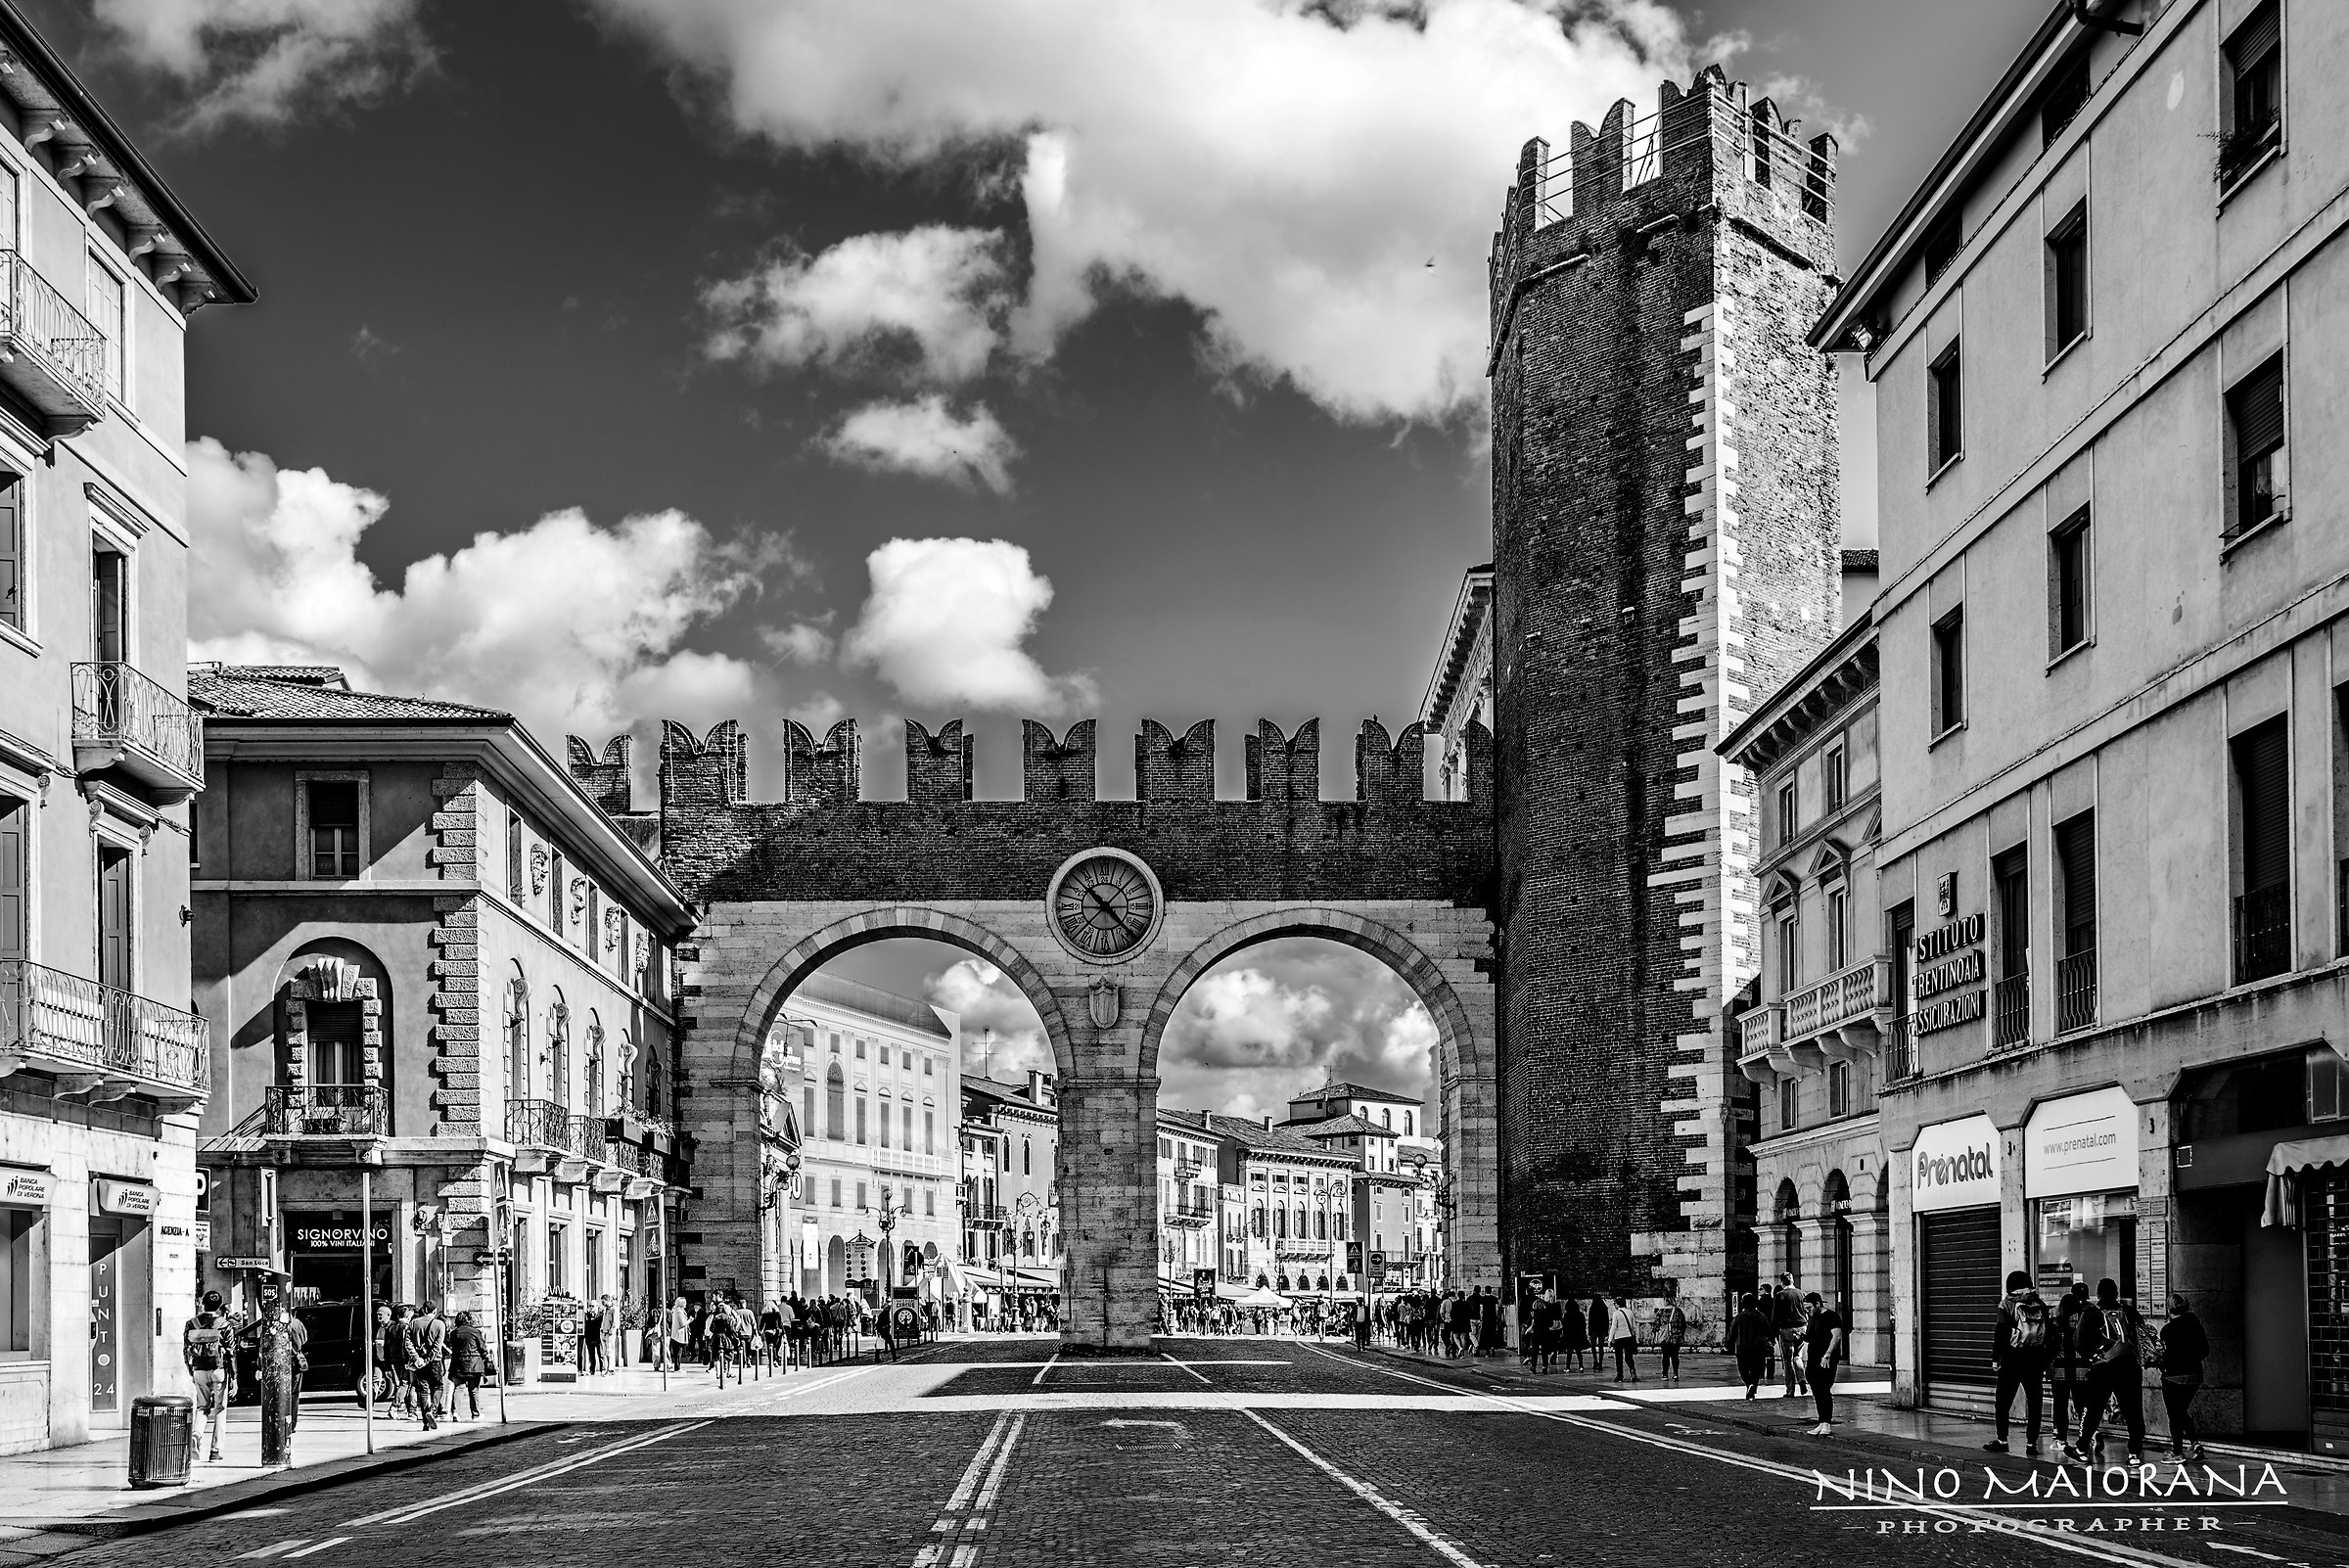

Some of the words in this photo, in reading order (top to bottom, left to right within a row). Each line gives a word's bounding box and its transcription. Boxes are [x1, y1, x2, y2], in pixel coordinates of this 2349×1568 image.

[1098, 863, 1110, 876] XII
[1915, 913, 1978, 961] STITUTO
[1912, 991, 1980, 1036] ASSICURAZIONI
[2044, 1132, 2116, 1155] www.prenatal.com
[298, 1228, 388, 1240] SIGNORVINO
